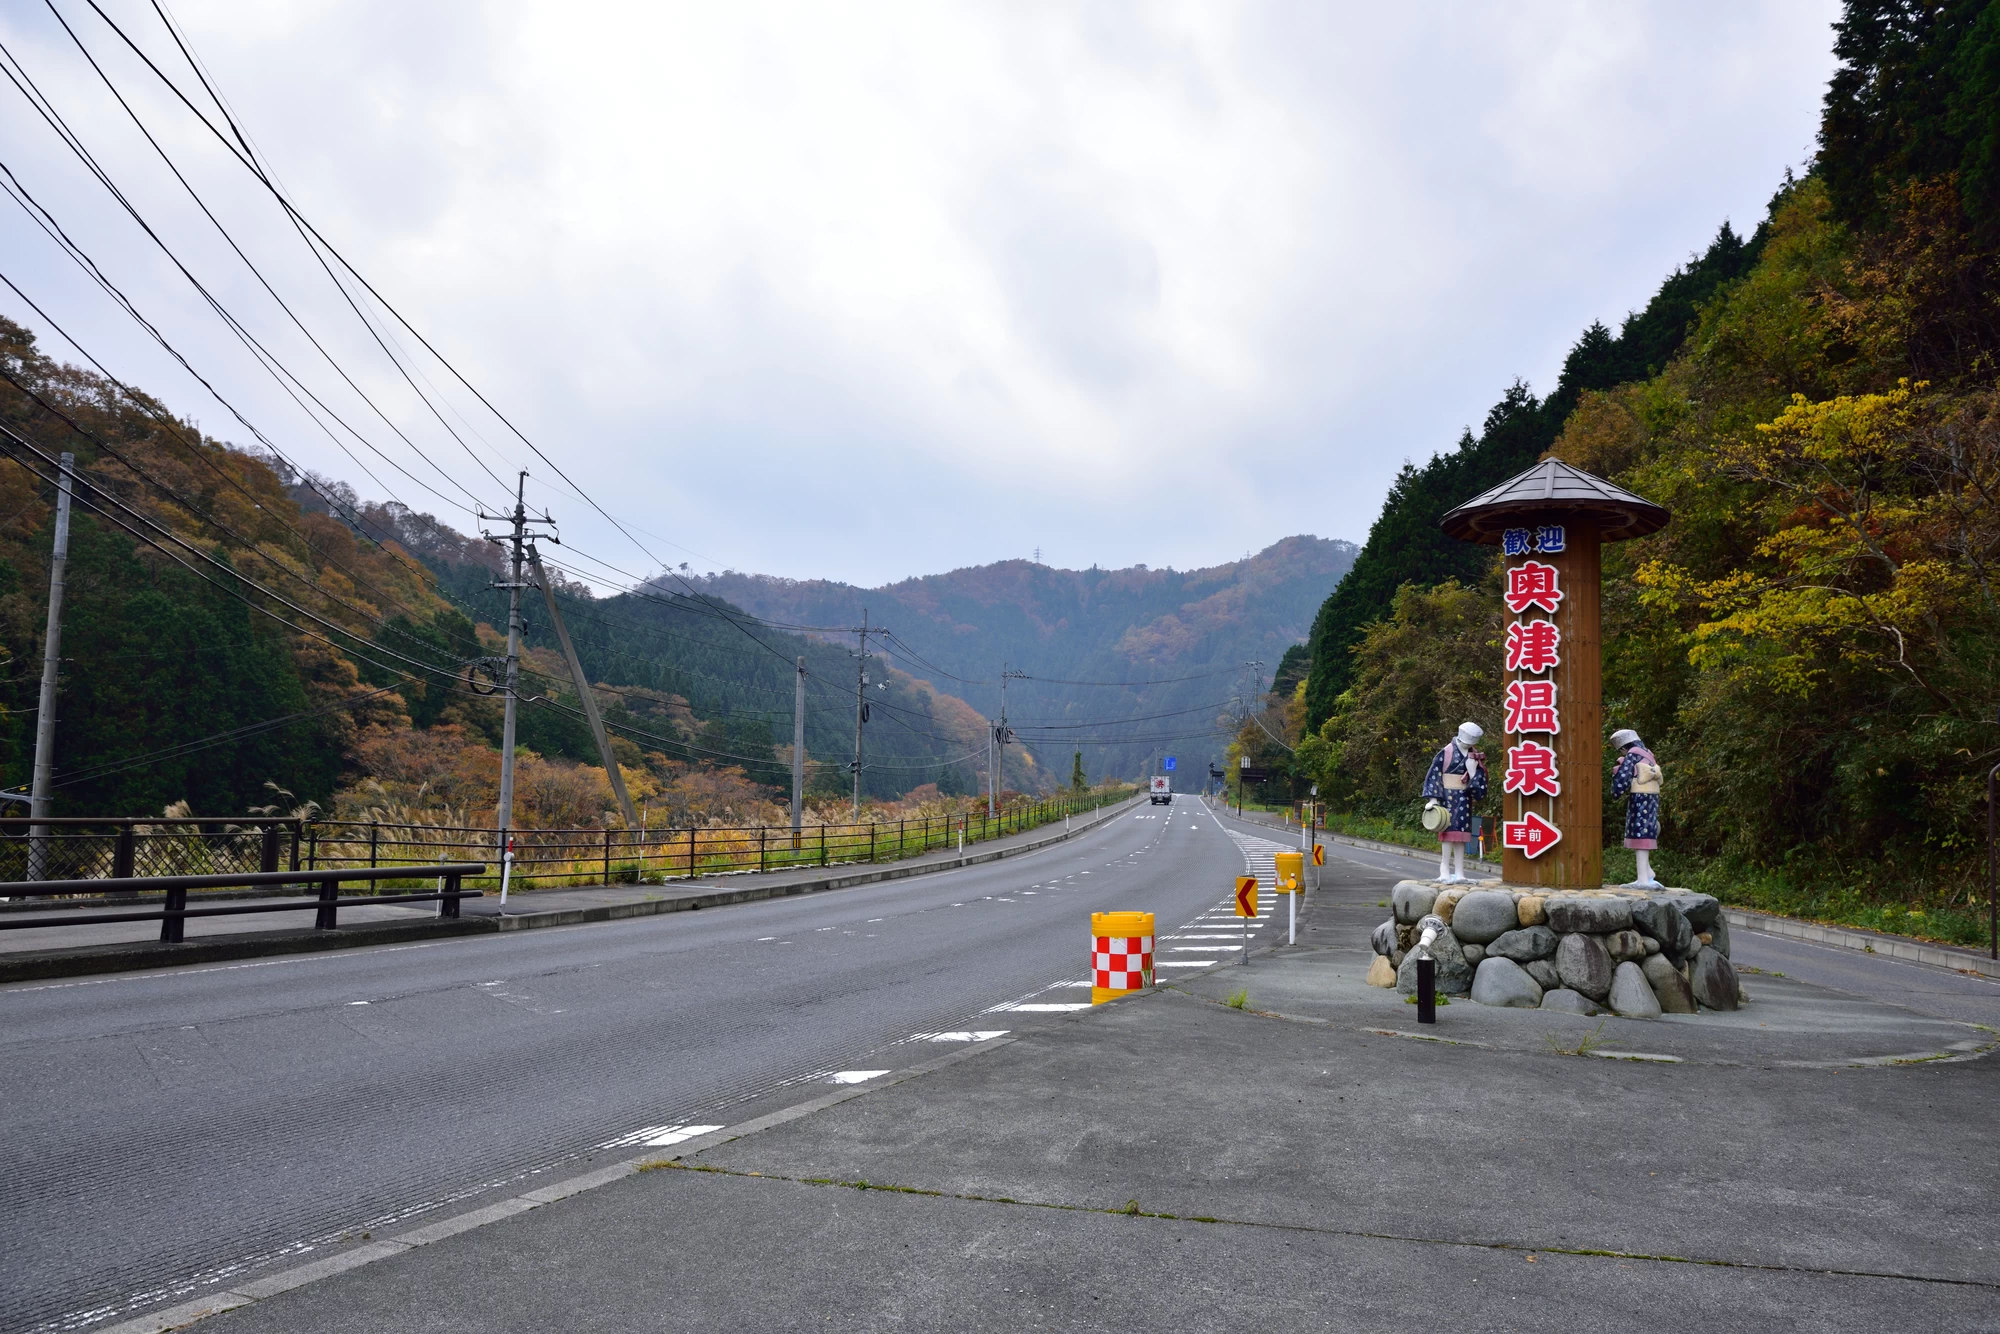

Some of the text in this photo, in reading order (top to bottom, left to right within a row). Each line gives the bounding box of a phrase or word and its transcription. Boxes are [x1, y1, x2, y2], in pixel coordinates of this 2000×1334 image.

[1503, 525, 1565, 555] 歓迎
[1504, 561, 1564, 796] 奥津温泉
[1513, 828, 1542, 842] 手前
